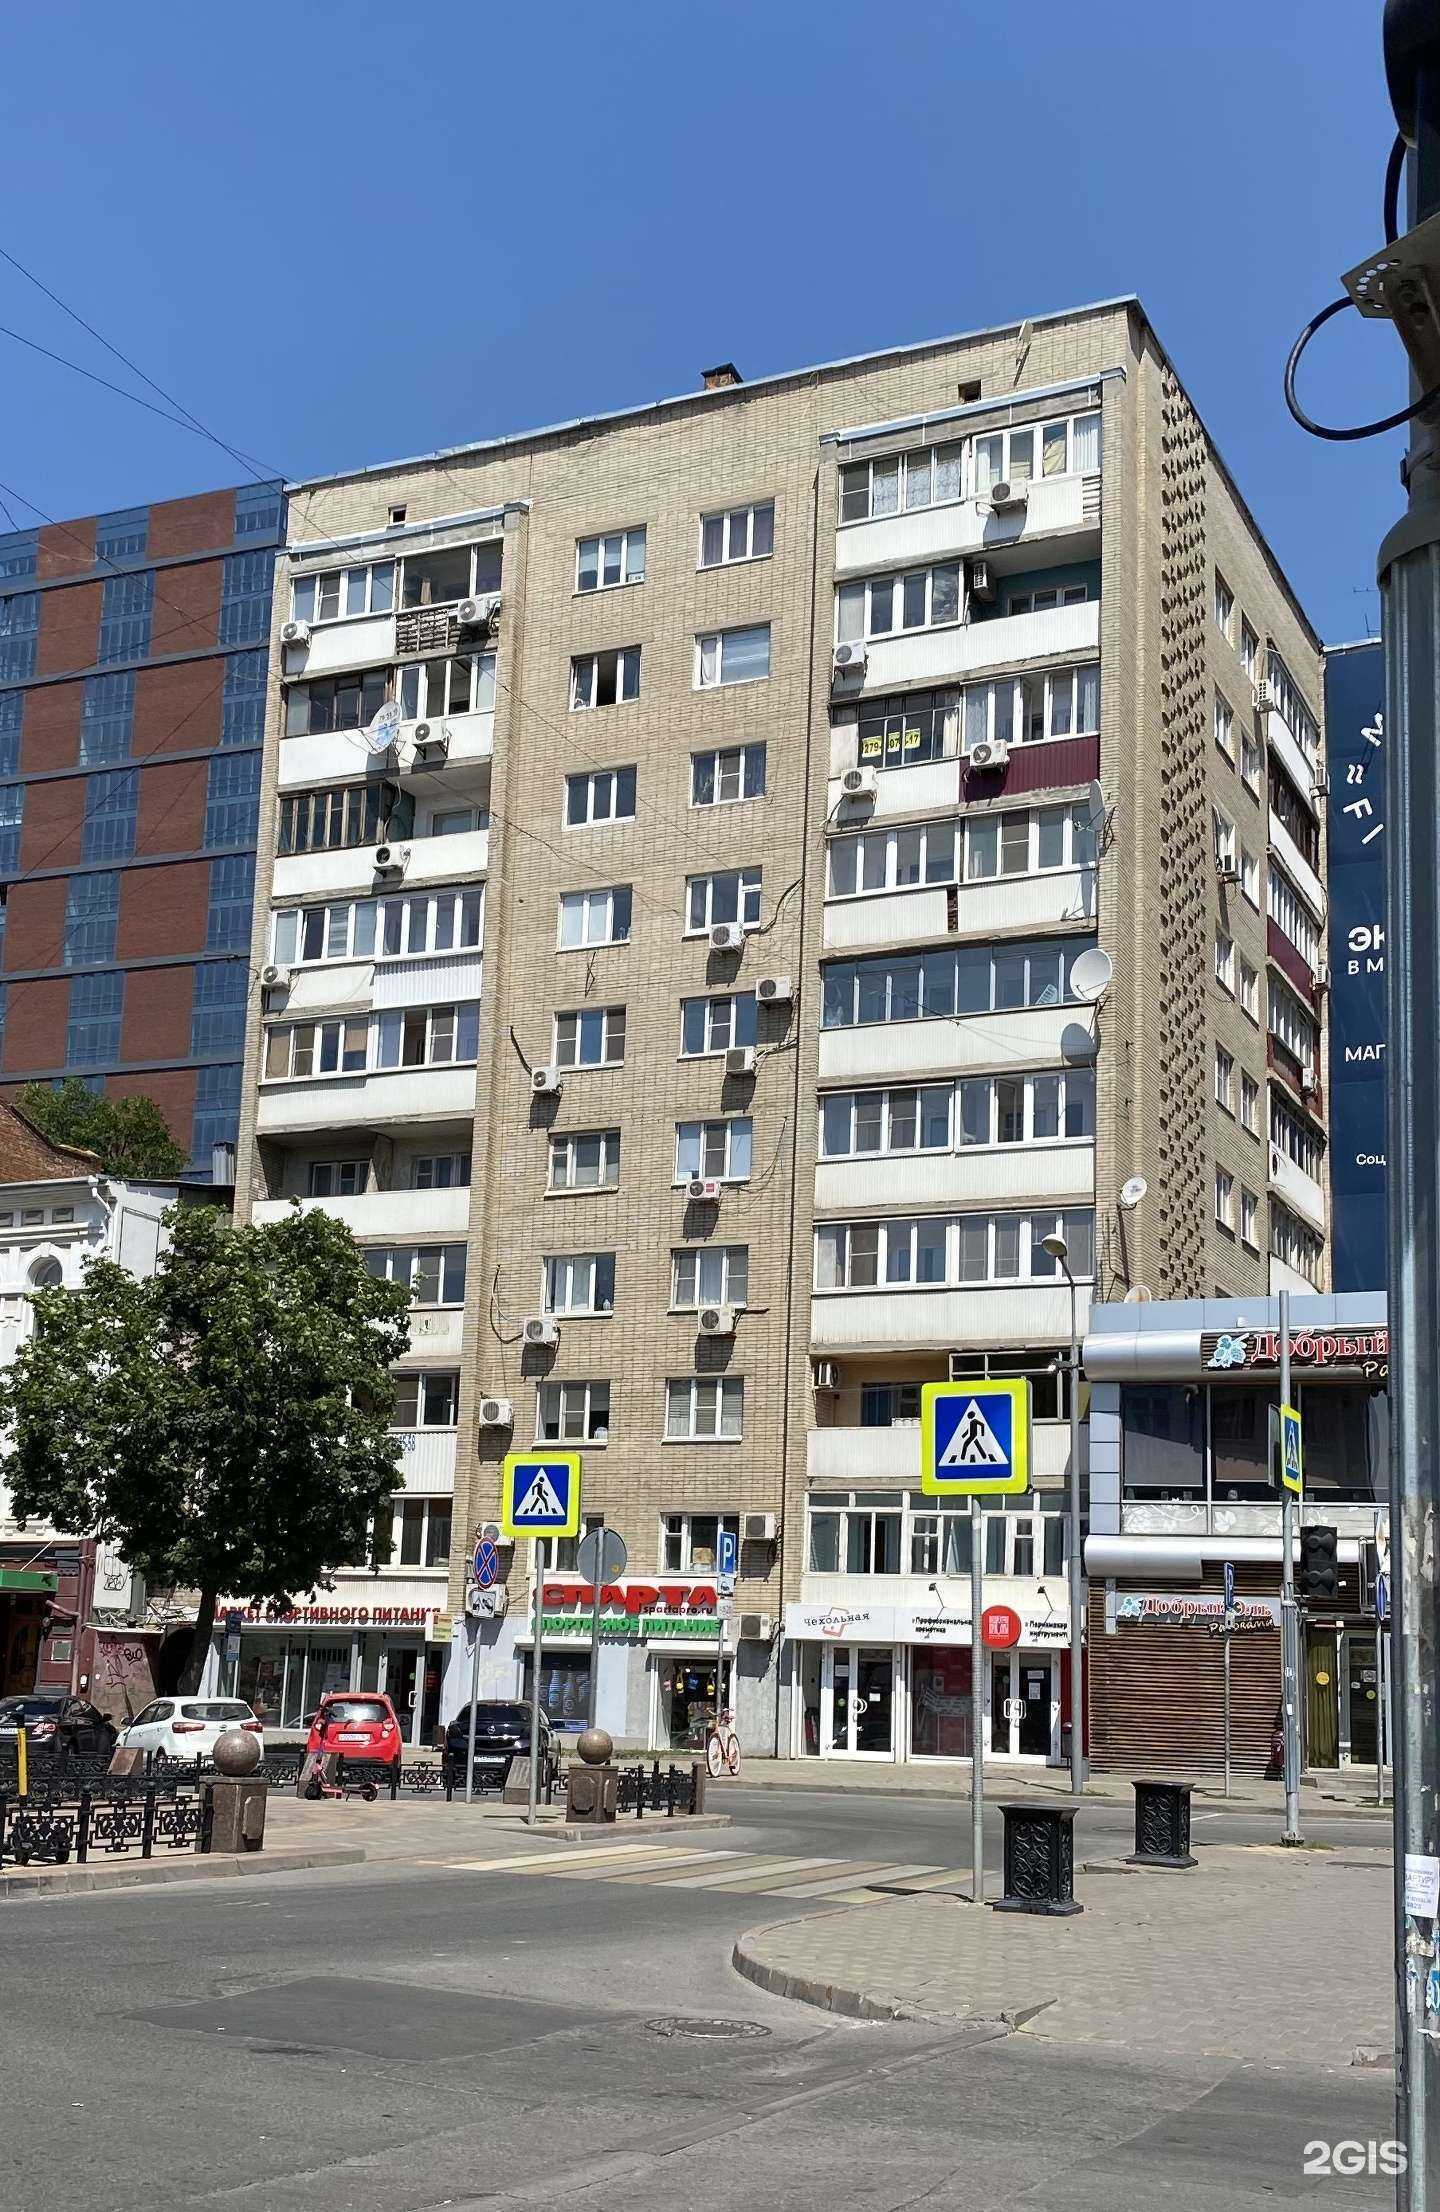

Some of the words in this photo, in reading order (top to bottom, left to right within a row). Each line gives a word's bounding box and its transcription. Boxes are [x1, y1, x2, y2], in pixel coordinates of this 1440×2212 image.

[723, 1537, 733, 1569] P
[534, 1584, 719, 1614] СПАРТА
[266, 1607, 369, 1622] СОРТИВНОГО
